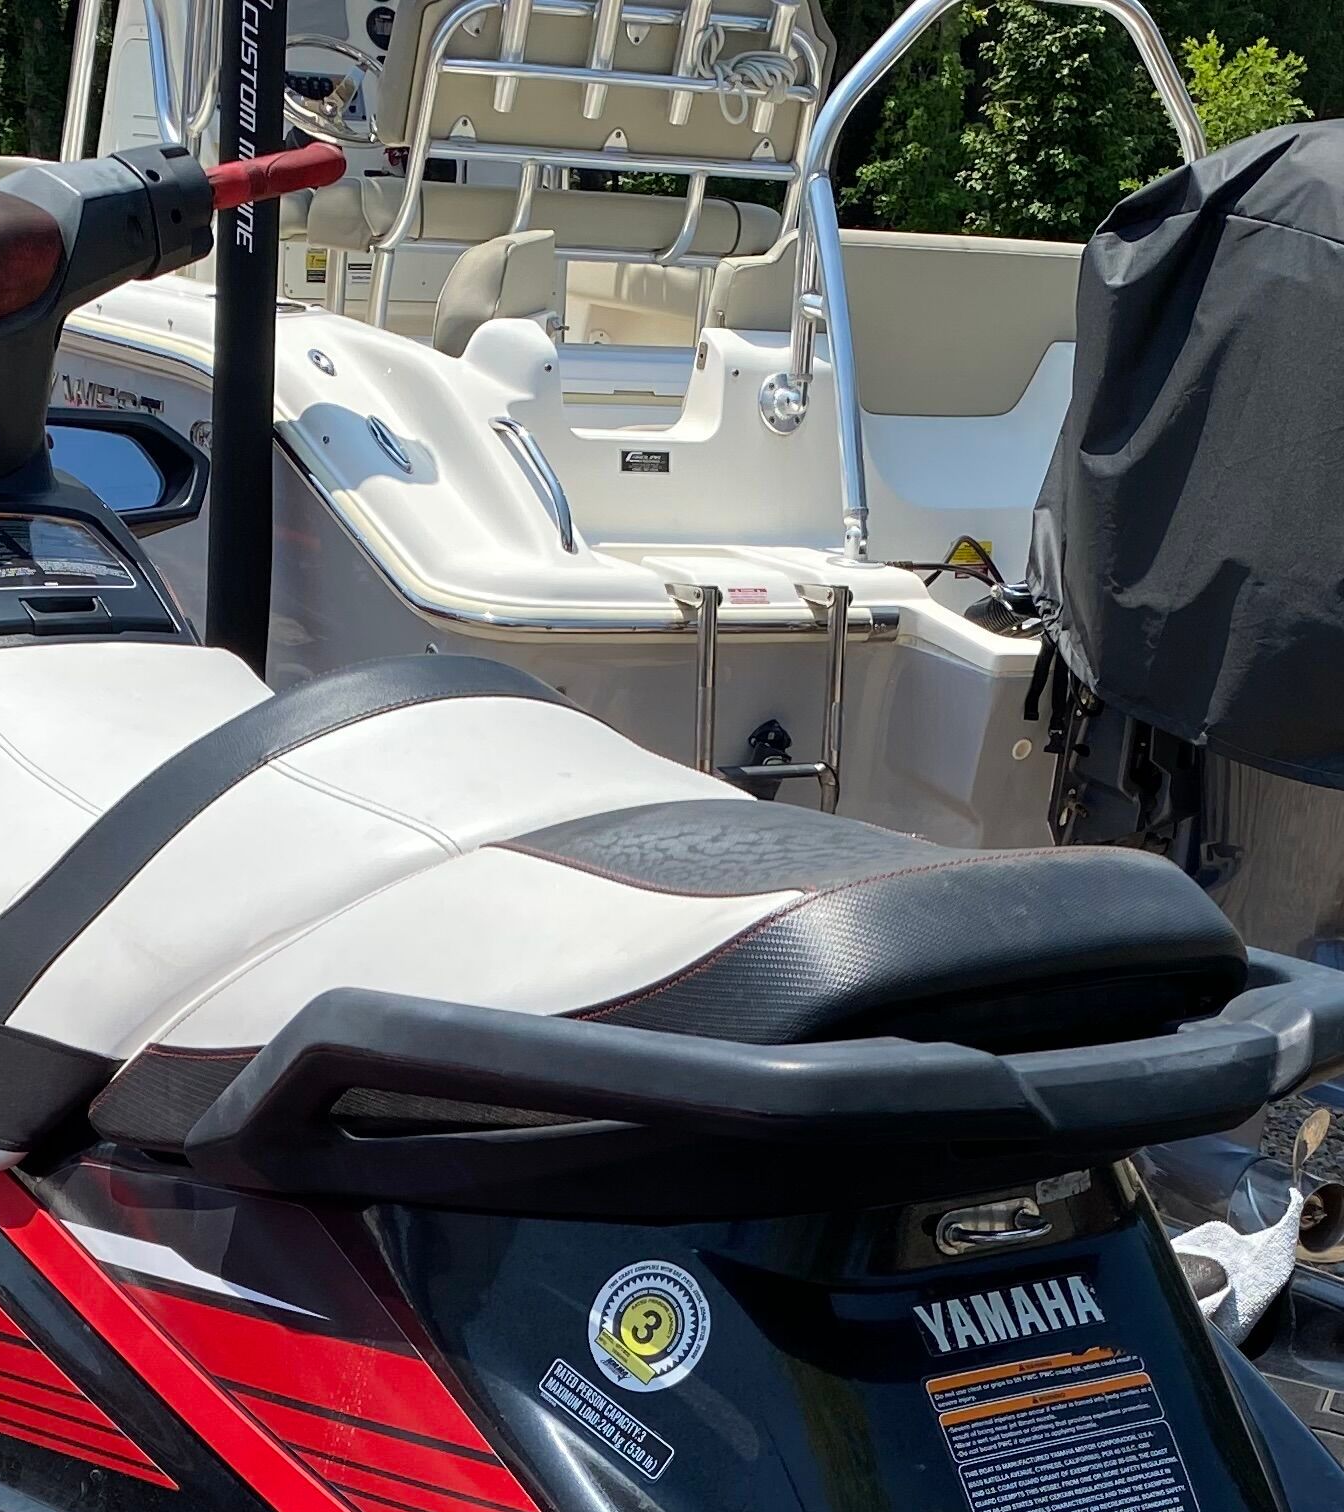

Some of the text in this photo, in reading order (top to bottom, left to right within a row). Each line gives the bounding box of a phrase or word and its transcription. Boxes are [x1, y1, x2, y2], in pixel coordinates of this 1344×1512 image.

[236, 0, 259, 253] CUSTOM MINE
[631, 1309, 663, 1345] 3
[913, 1276, 1106, 1353] YAMAHA
[545, 1377, 582, 1410] MAXIMUM
[612, 1431, 626, 1449] kg
[622, 1440, 646, 1463] (530
[641, 1455, 658, 1473] lb)
[554, 1363, 579, 1389] RATED
[576, 1382, 607, 1411] PERSON
